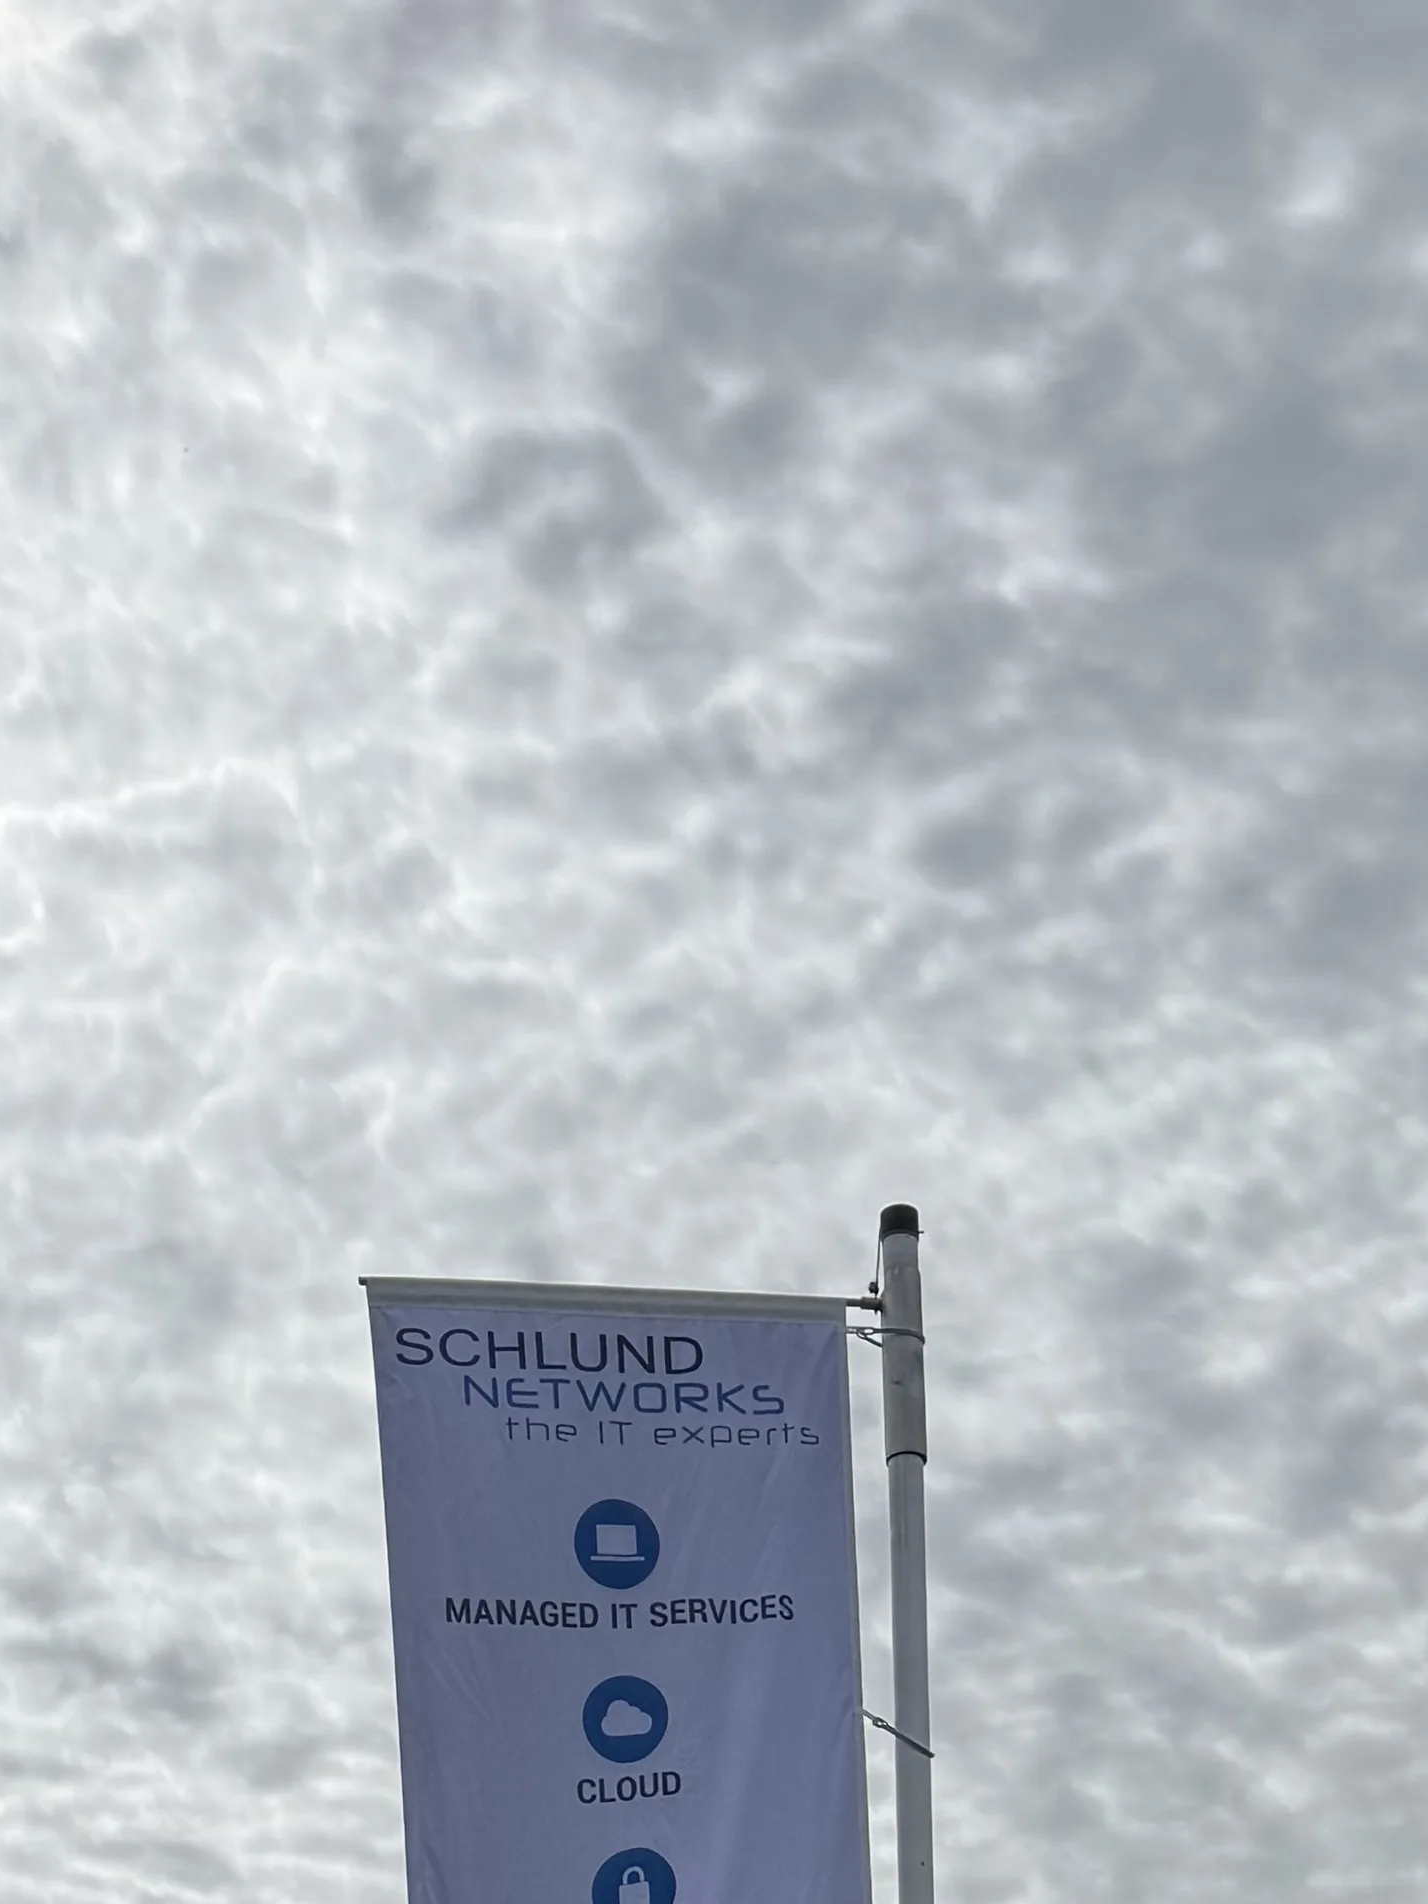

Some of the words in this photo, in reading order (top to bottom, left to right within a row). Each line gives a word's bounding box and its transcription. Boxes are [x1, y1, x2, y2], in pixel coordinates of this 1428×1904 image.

[396, 1328, 703, 1374] SCHLUND
[464, 1375, 784, 1415] NETWORKS
[506, 1417, 576, 1442] the
[599, 1421, 632, 1445] IT
[654, 1423, 819, 1448] experts
[446, 1598, 598, 1628] MANAGED
[611, 1604, 638, 1629] IT
[650, 1595, 794, 1627] SERVICES
[577, 1771, 681, 1803] CLOUD
